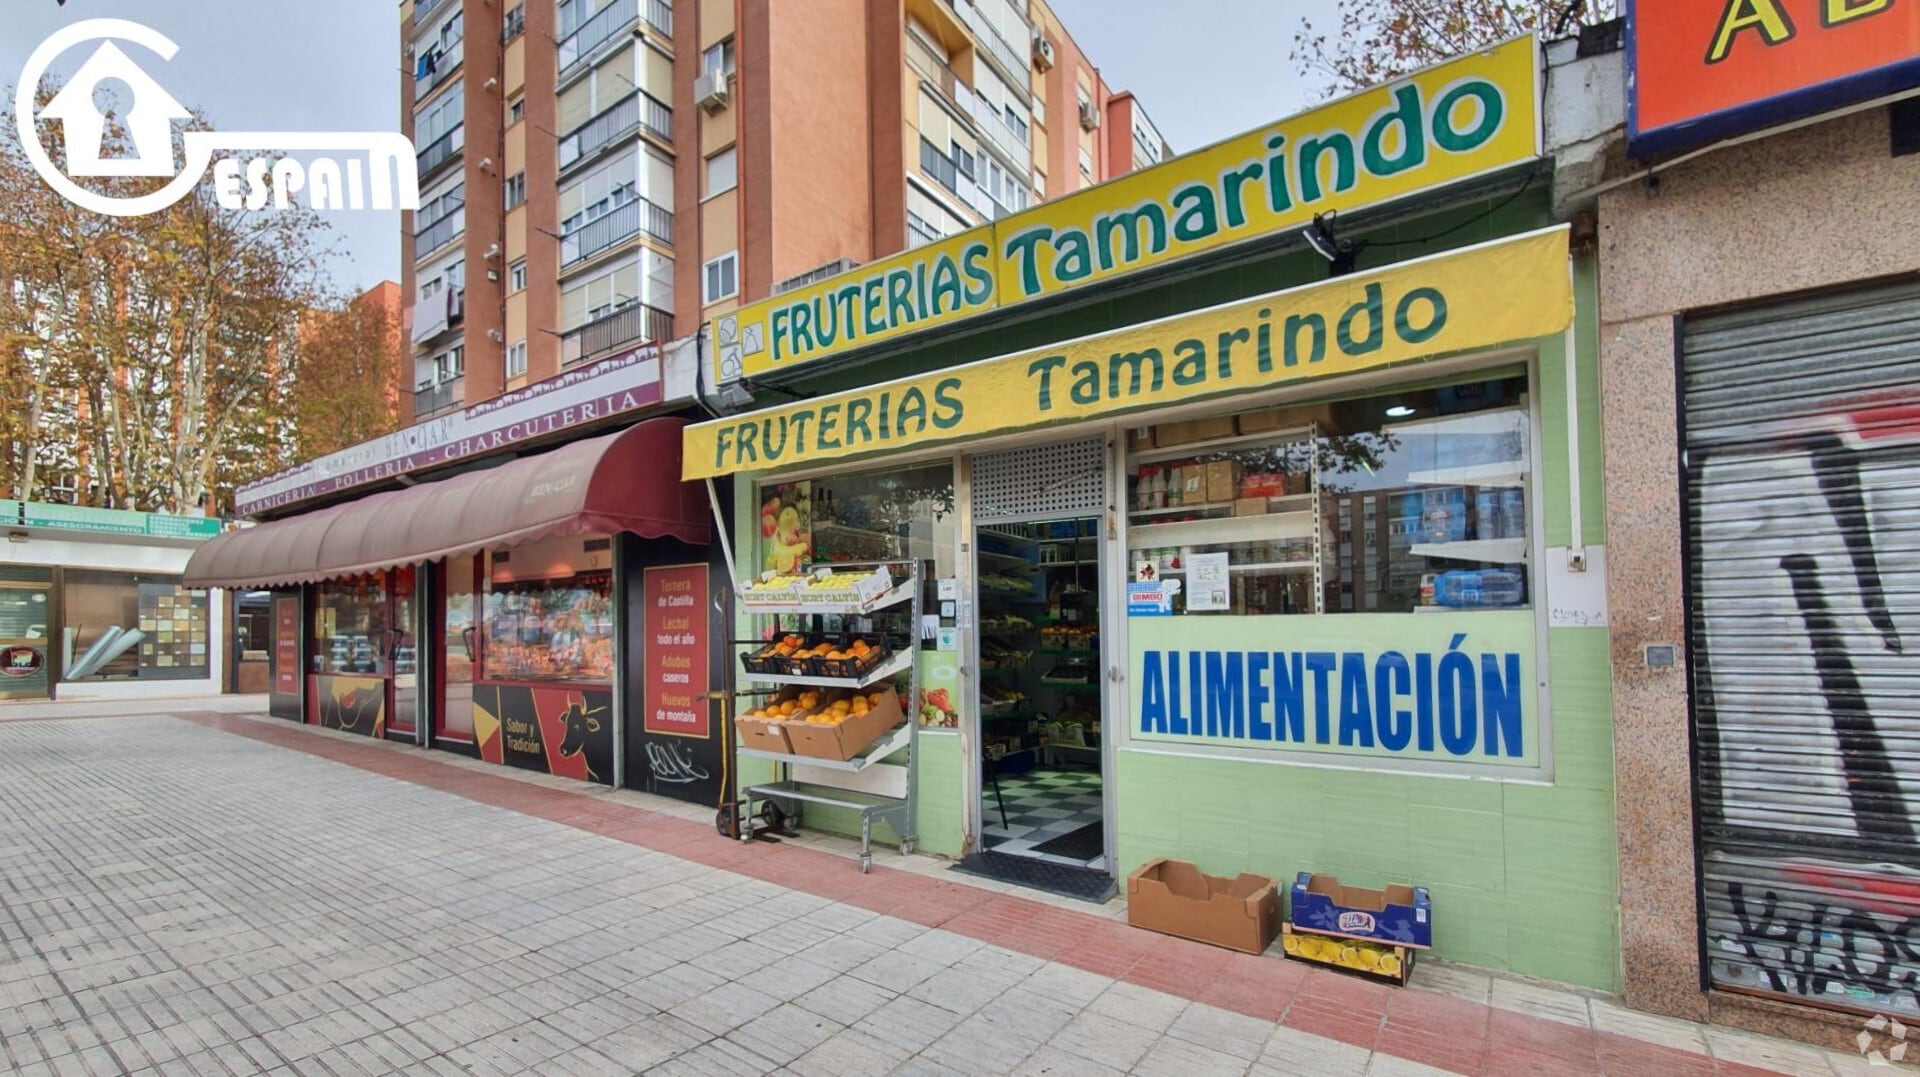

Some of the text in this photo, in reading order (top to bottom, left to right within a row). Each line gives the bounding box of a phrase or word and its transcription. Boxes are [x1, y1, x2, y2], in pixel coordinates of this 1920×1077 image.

[771, 79, 1504, 361] FRUTERIAS Tamarindo
[715, 281, 1448, 468] FRUTERIAS Tamarindo
[242, 483, 317, 515] CARNICERIA
[335, 457, 416, 490] POLLERIA
[444, 390, 639, 461] CHARCUTERIA
[661, 579, 691, 592] Ternera
[658, 595, 694, 607] de Castilla
[663, 616, 689, 630] Lechal
[657, 634, 673, 645] todo
[661, 655, 691, 669] Adobos
[663, 673, 689, 684] caseros
[661, 692, 691, 708] Huevos
[1140, 633, 1524, 758] ALIMENTACIÓN
[656, 709, 696, 724] de montaña
[506, 717, 528, 734] Sabor
[506, 735, 540, 754] Tradición
